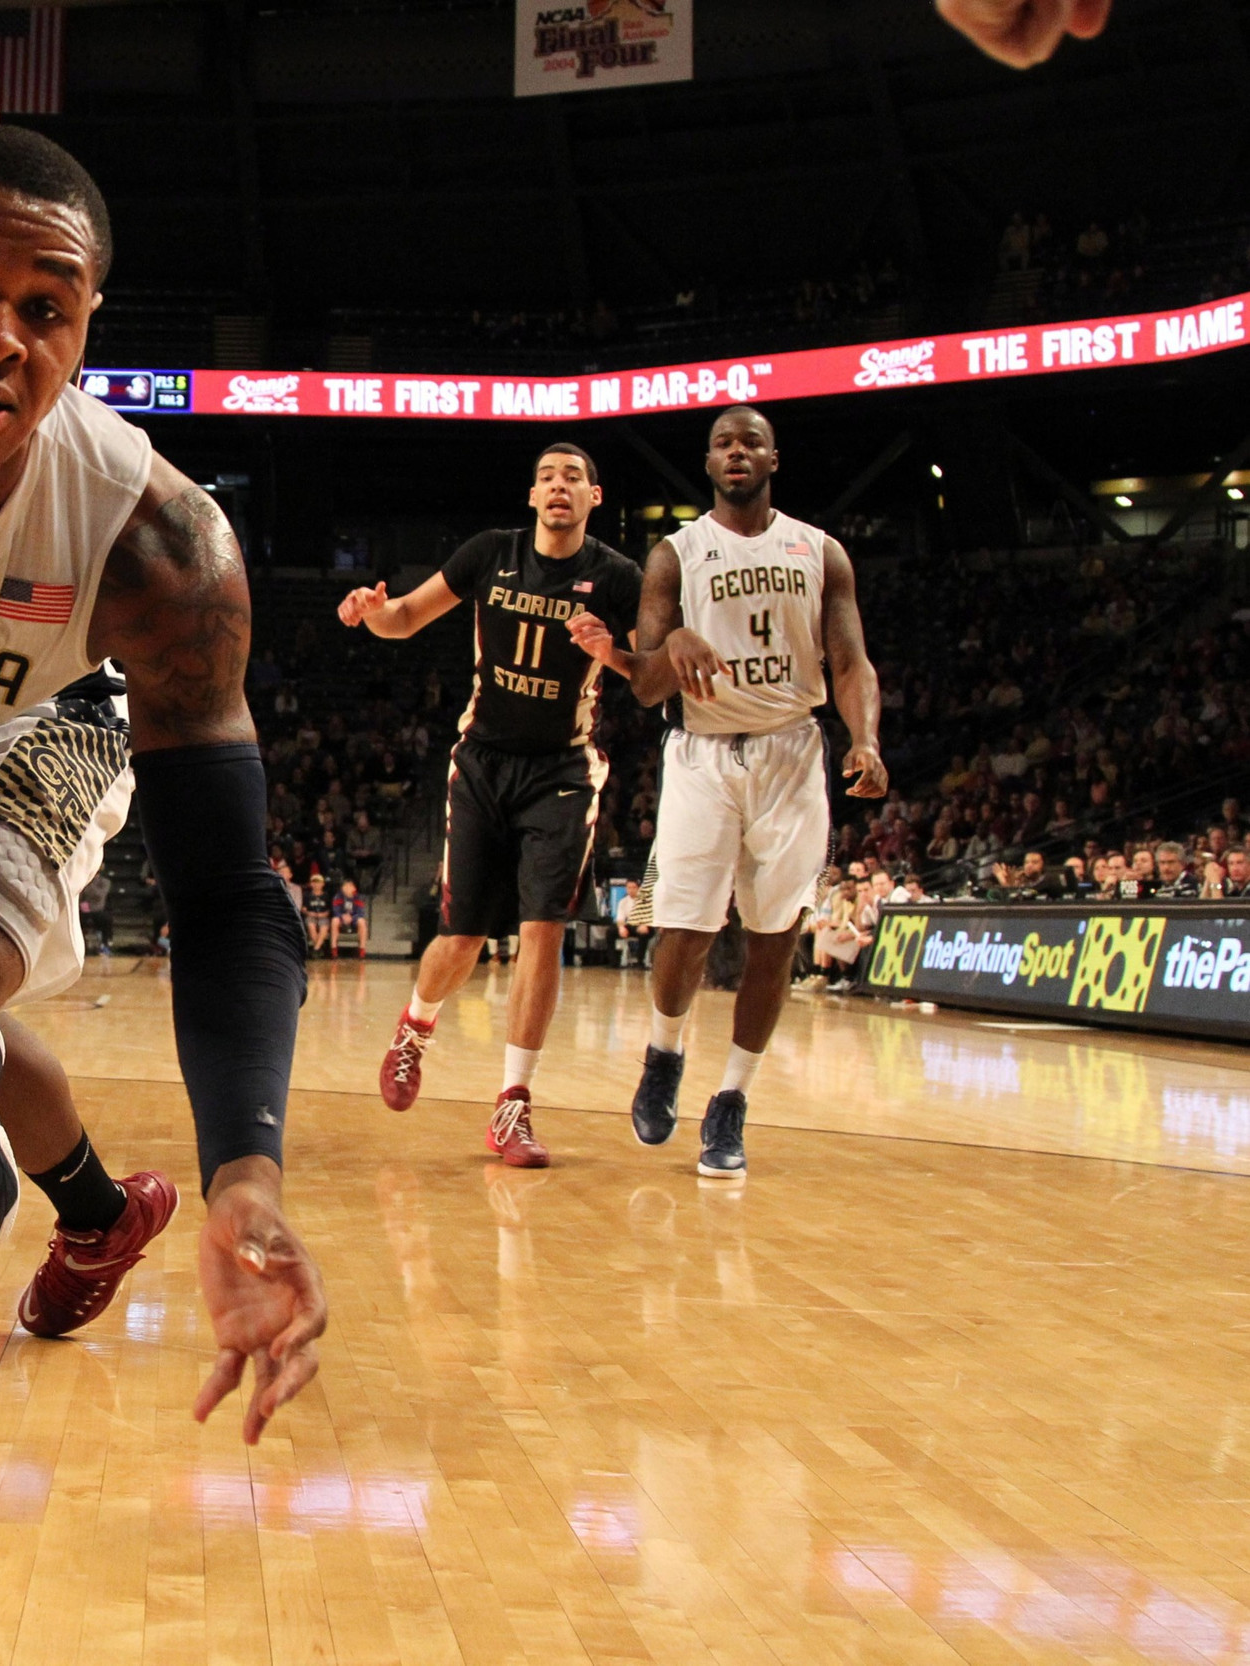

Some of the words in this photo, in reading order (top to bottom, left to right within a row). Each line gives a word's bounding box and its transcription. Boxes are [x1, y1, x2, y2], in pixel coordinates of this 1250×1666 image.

[536, 7, 586, 26] NCAA
[534, 17, 620, 58] Final
[576, 40, 657, 78] Four
[962, 333, 1028, 374] THE
[1042, 322, 1140, 367] FIRST
[1155, 301, 1245, 356] NAME
[854, 340, 936, 386] Sonny's
[155, 376, 174, 388] FLS
[222, 374, 300, 410] Sonny's
[323, 378, 383, 412] THE
[394, 379, 480, 415] FIRST
[492, 381, 579, 416] NAME
[591, 378, 620, 413] IN
[710, 566, 806, 602] GEORGIA
[487, 585, 586, 621] FLORIDA
[513, 621, 546, 669] 11
[750, 609, 772, 647] 4
[493, 665, 561, 700] STATE
[727, 654, 792, 687] TECH
